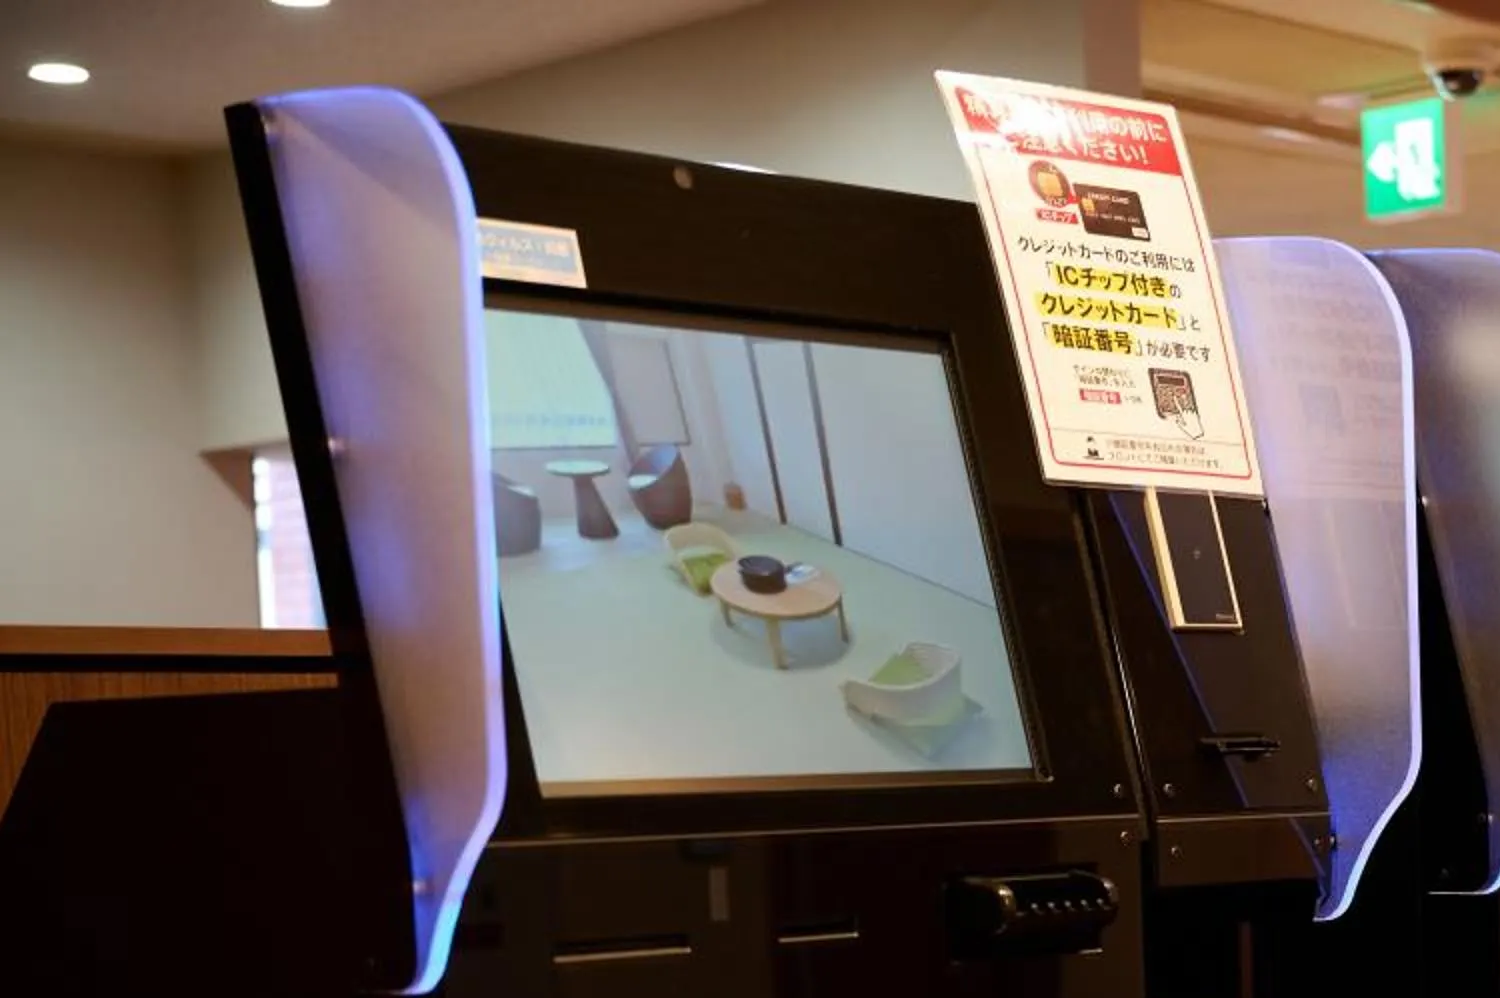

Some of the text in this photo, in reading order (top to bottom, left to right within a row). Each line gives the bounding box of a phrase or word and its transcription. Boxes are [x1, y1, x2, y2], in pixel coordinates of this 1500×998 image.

[1018, 236, 1195, 273] クレジットカードのご利用には
[1045, 261, 1182, 299] 「ICチップ付きの
[1042, 293, 1202, 331] クレジットカード」と
[1042, 322, 1212, 363] 「暗証番号」が必要です
